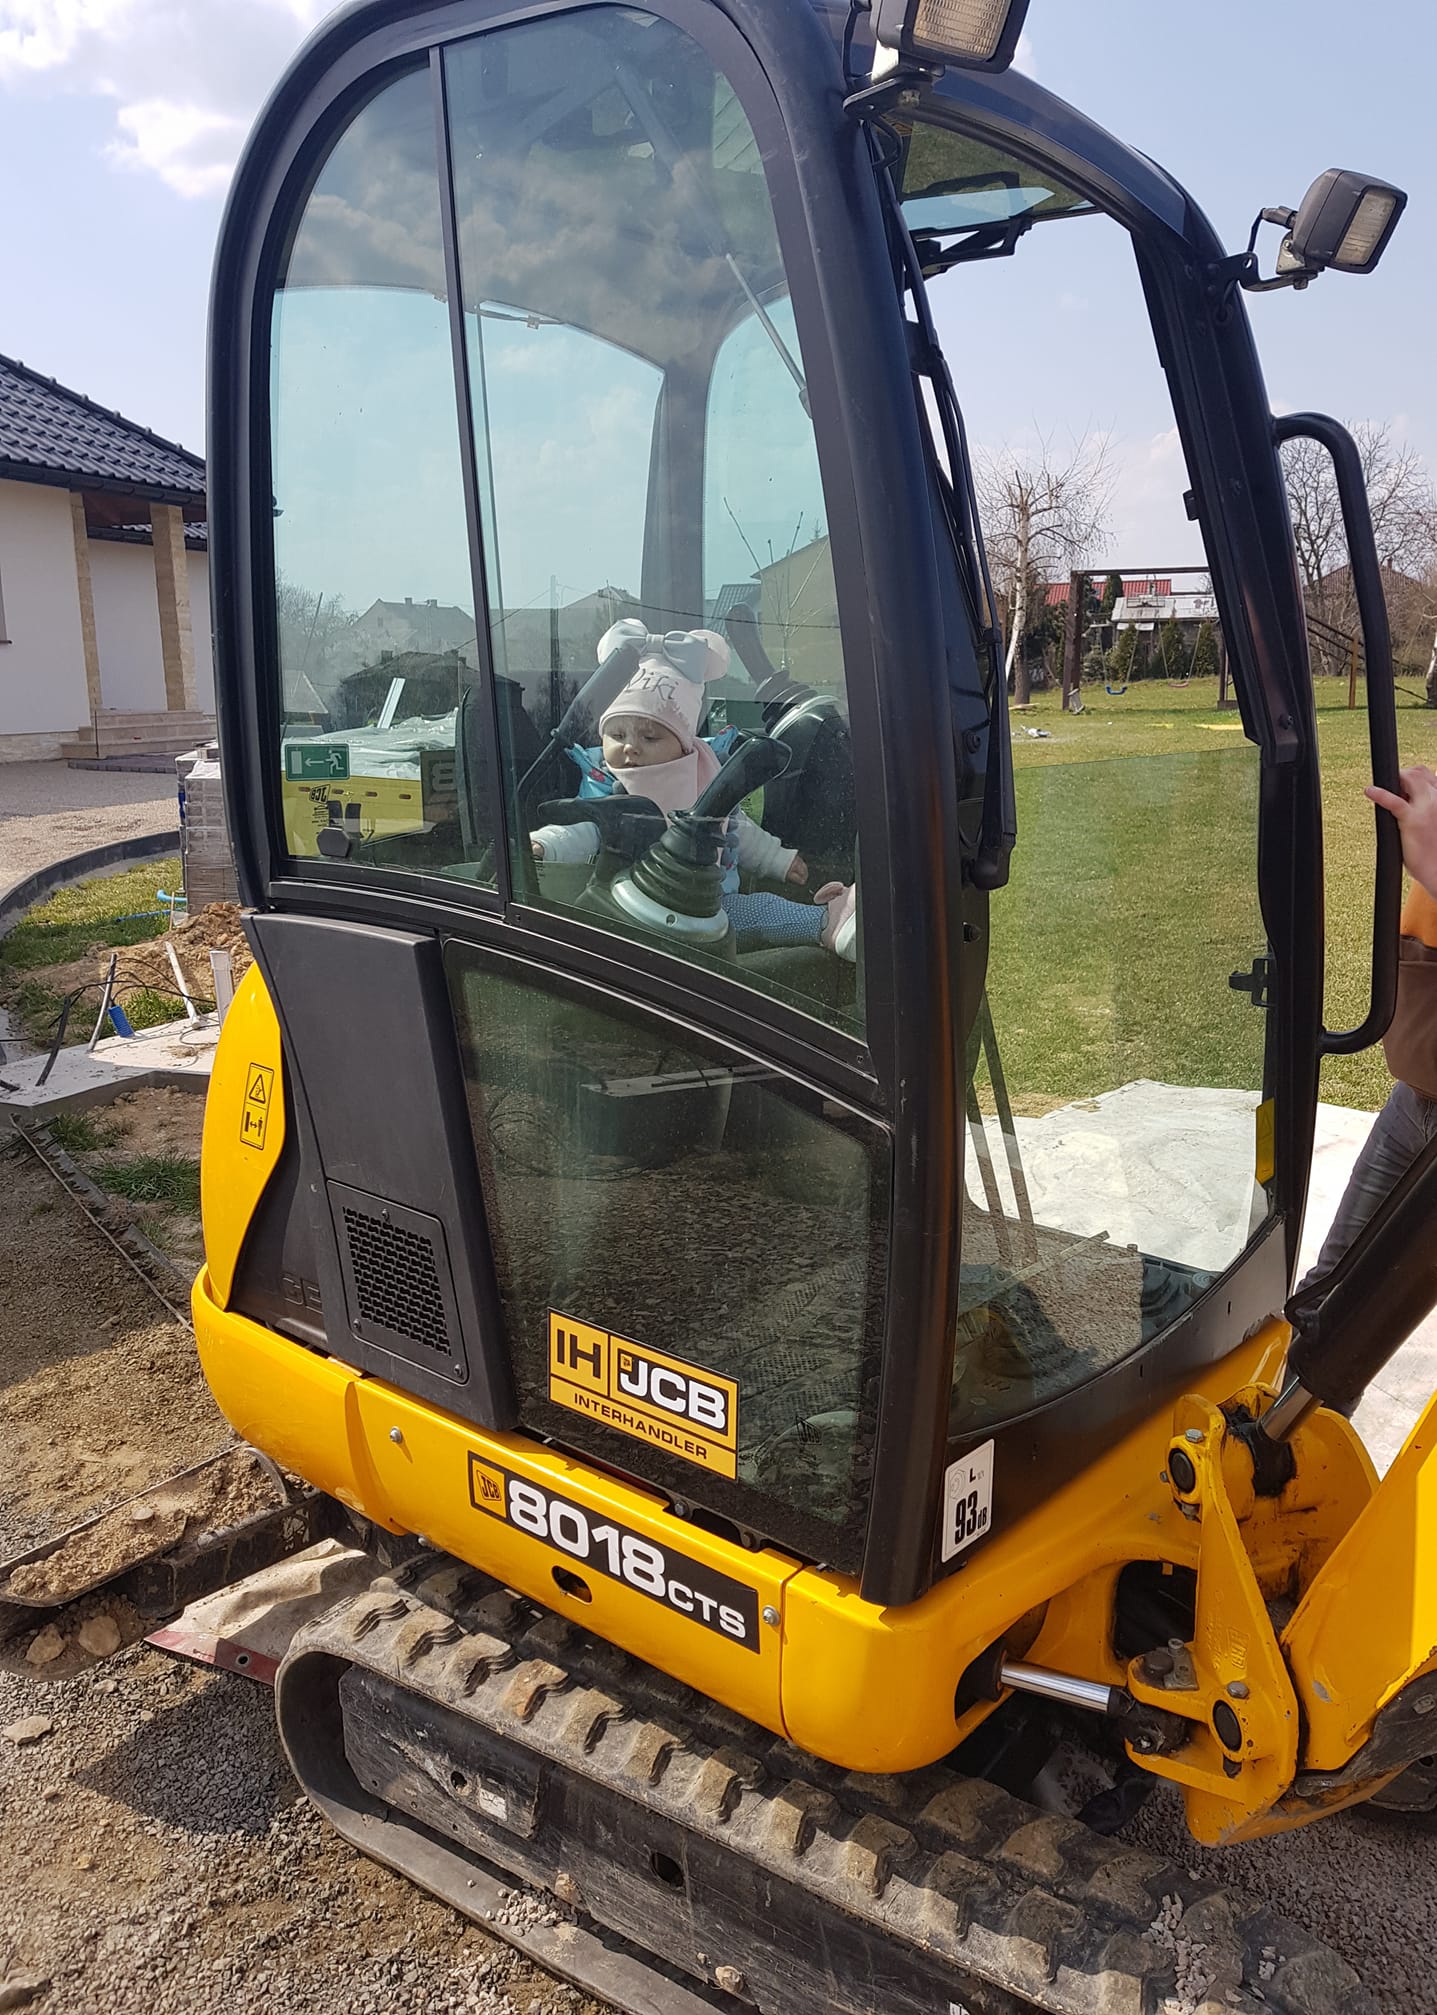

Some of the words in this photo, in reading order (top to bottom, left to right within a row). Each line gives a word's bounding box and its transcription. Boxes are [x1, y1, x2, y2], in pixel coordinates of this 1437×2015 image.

[556, 1328, 602, 1380] IH
[573, 1392, 708, 1460] INTERHANDLER
[619, 1360, 726, 1430] JCB
[480, 1474, 500, 1499] JCB
[508, 1479, 666, 1598] 8018
[954, 1490, 978, 1545] 93
